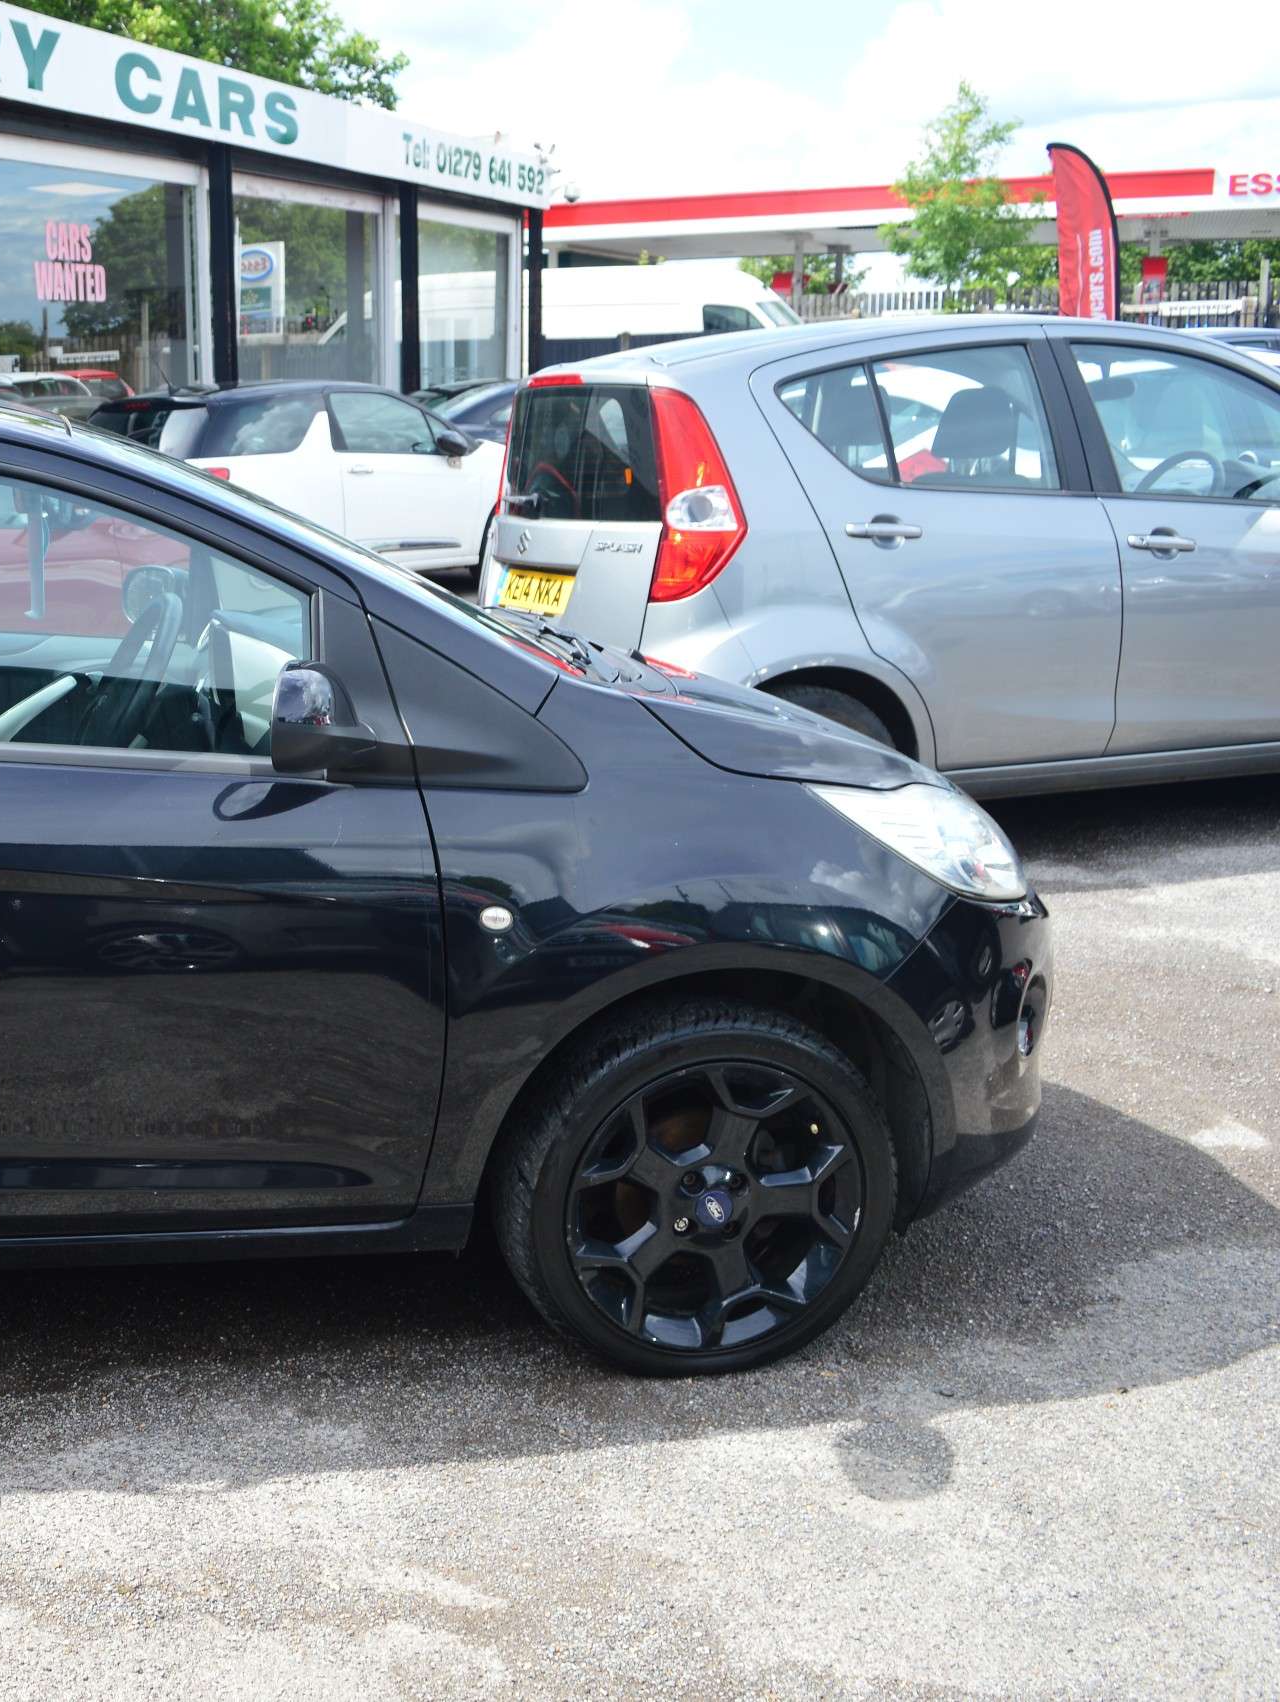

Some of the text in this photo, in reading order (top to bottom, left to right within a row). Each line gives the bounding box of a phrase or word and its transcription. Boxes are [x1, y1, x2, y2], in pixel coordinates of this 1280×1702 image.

[115, 52, 299, 145] CARS
[402, 131, 545, 195] Tel: 01279 641 592
[1229, 173, 1280, 196] ES
[45, 219, 92, 262] CARS
[34, 261, 107, 302] WANTED
[533, 576, 564, 607] NKA
